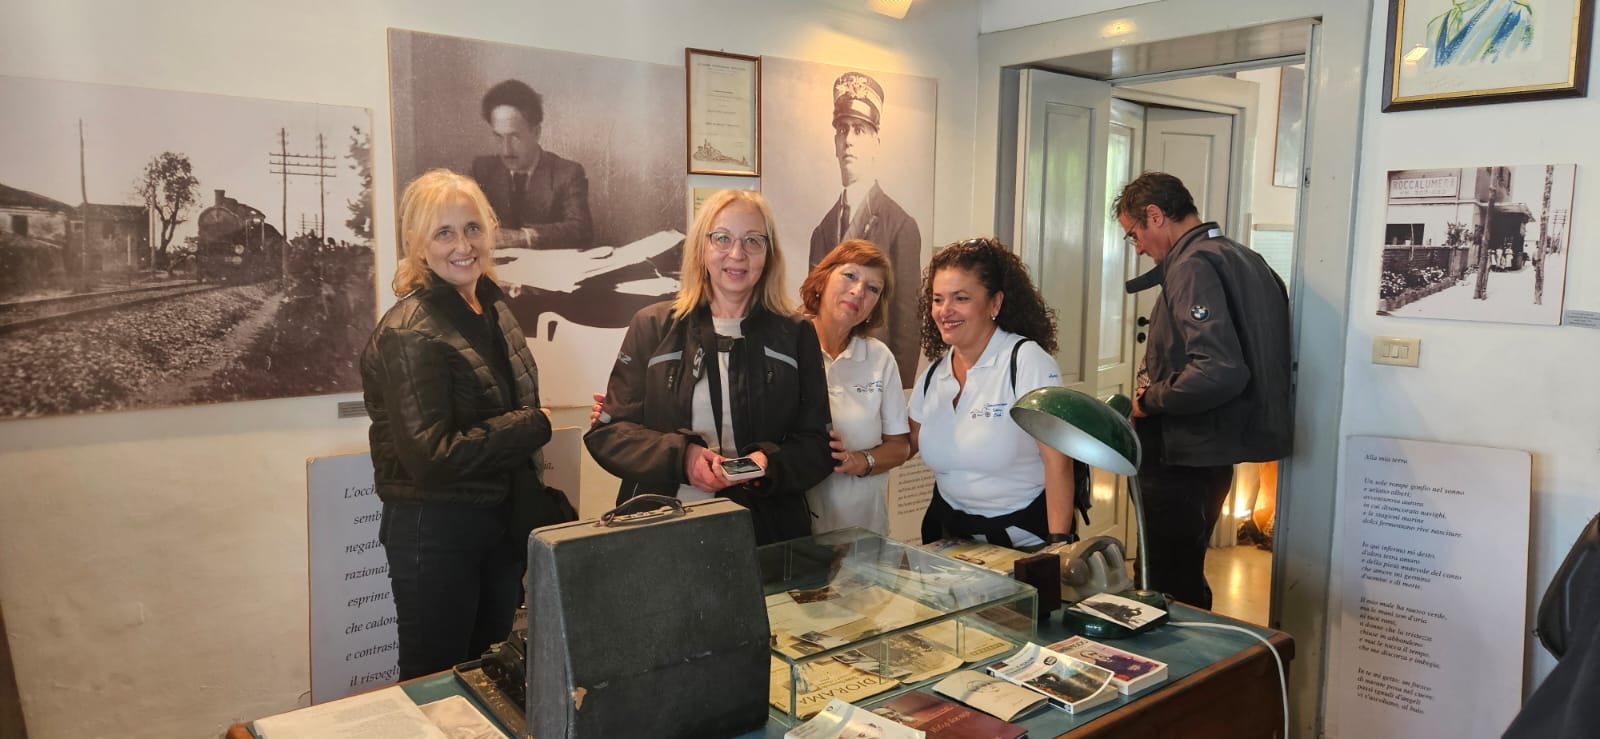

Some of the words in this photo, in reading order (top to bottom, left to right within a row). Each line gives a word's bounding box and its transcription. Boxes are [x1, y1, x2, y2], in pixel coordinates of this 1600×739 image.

[345, 562, 388, 581] razional
[347, 591, 390, 608] esprime
[345, 622, 364, 635] che
[365, 616, 398, 630] cadon
[346, 652, 352, 662] e
[350, 676, 358, 687] il
[799, 677, 876, 704] DIORAMA
